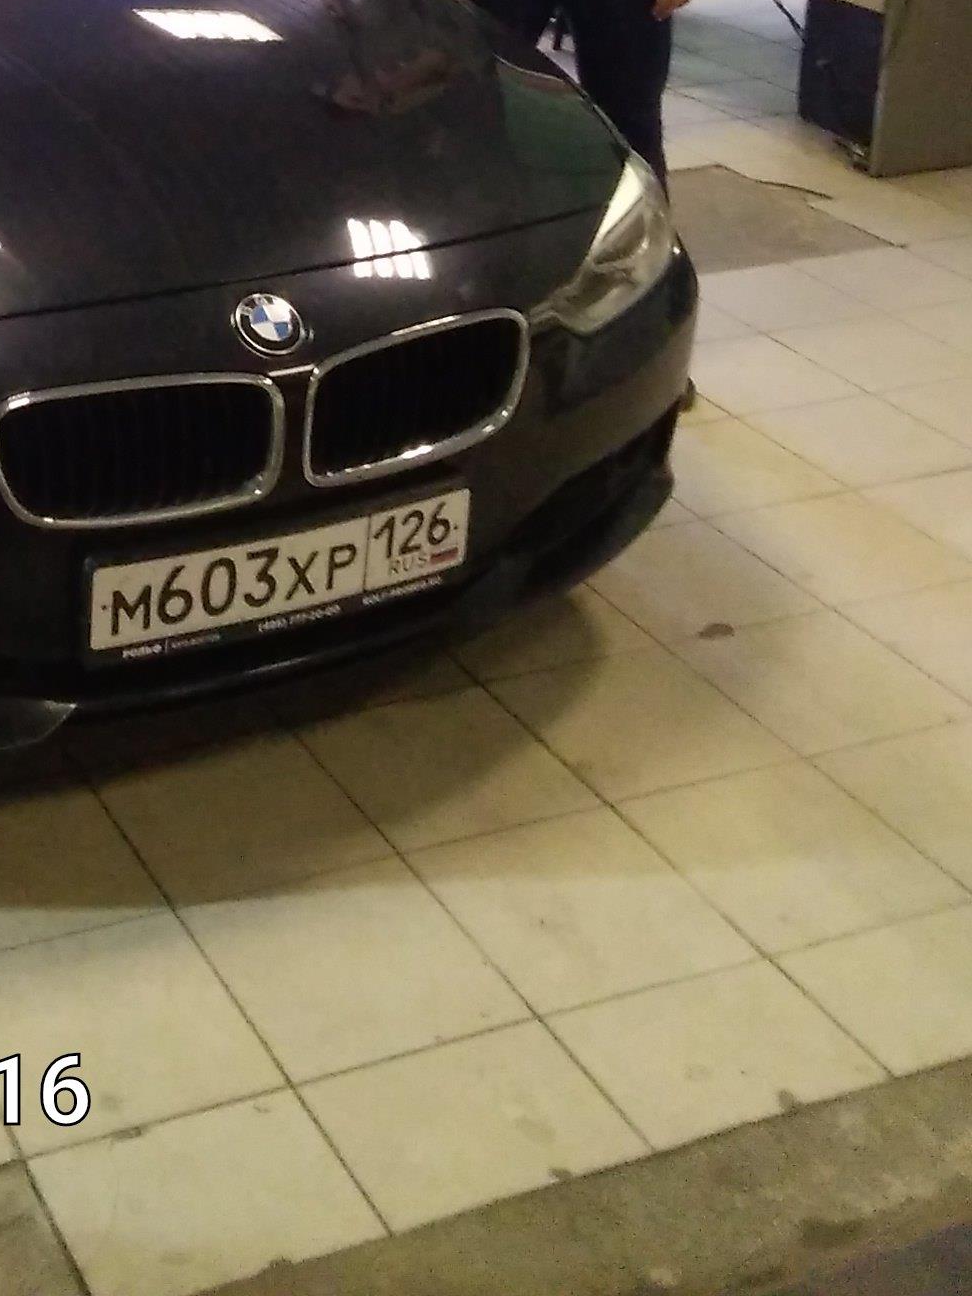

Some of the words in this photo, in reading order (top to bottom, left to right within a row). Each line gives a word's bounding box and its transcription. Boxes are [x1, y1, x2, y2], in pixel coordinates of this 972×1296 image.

[111, 543, 357, 636] М603ХР
[373, 502, 452, 559] 126
[389, 553, 429, 576] RUS
